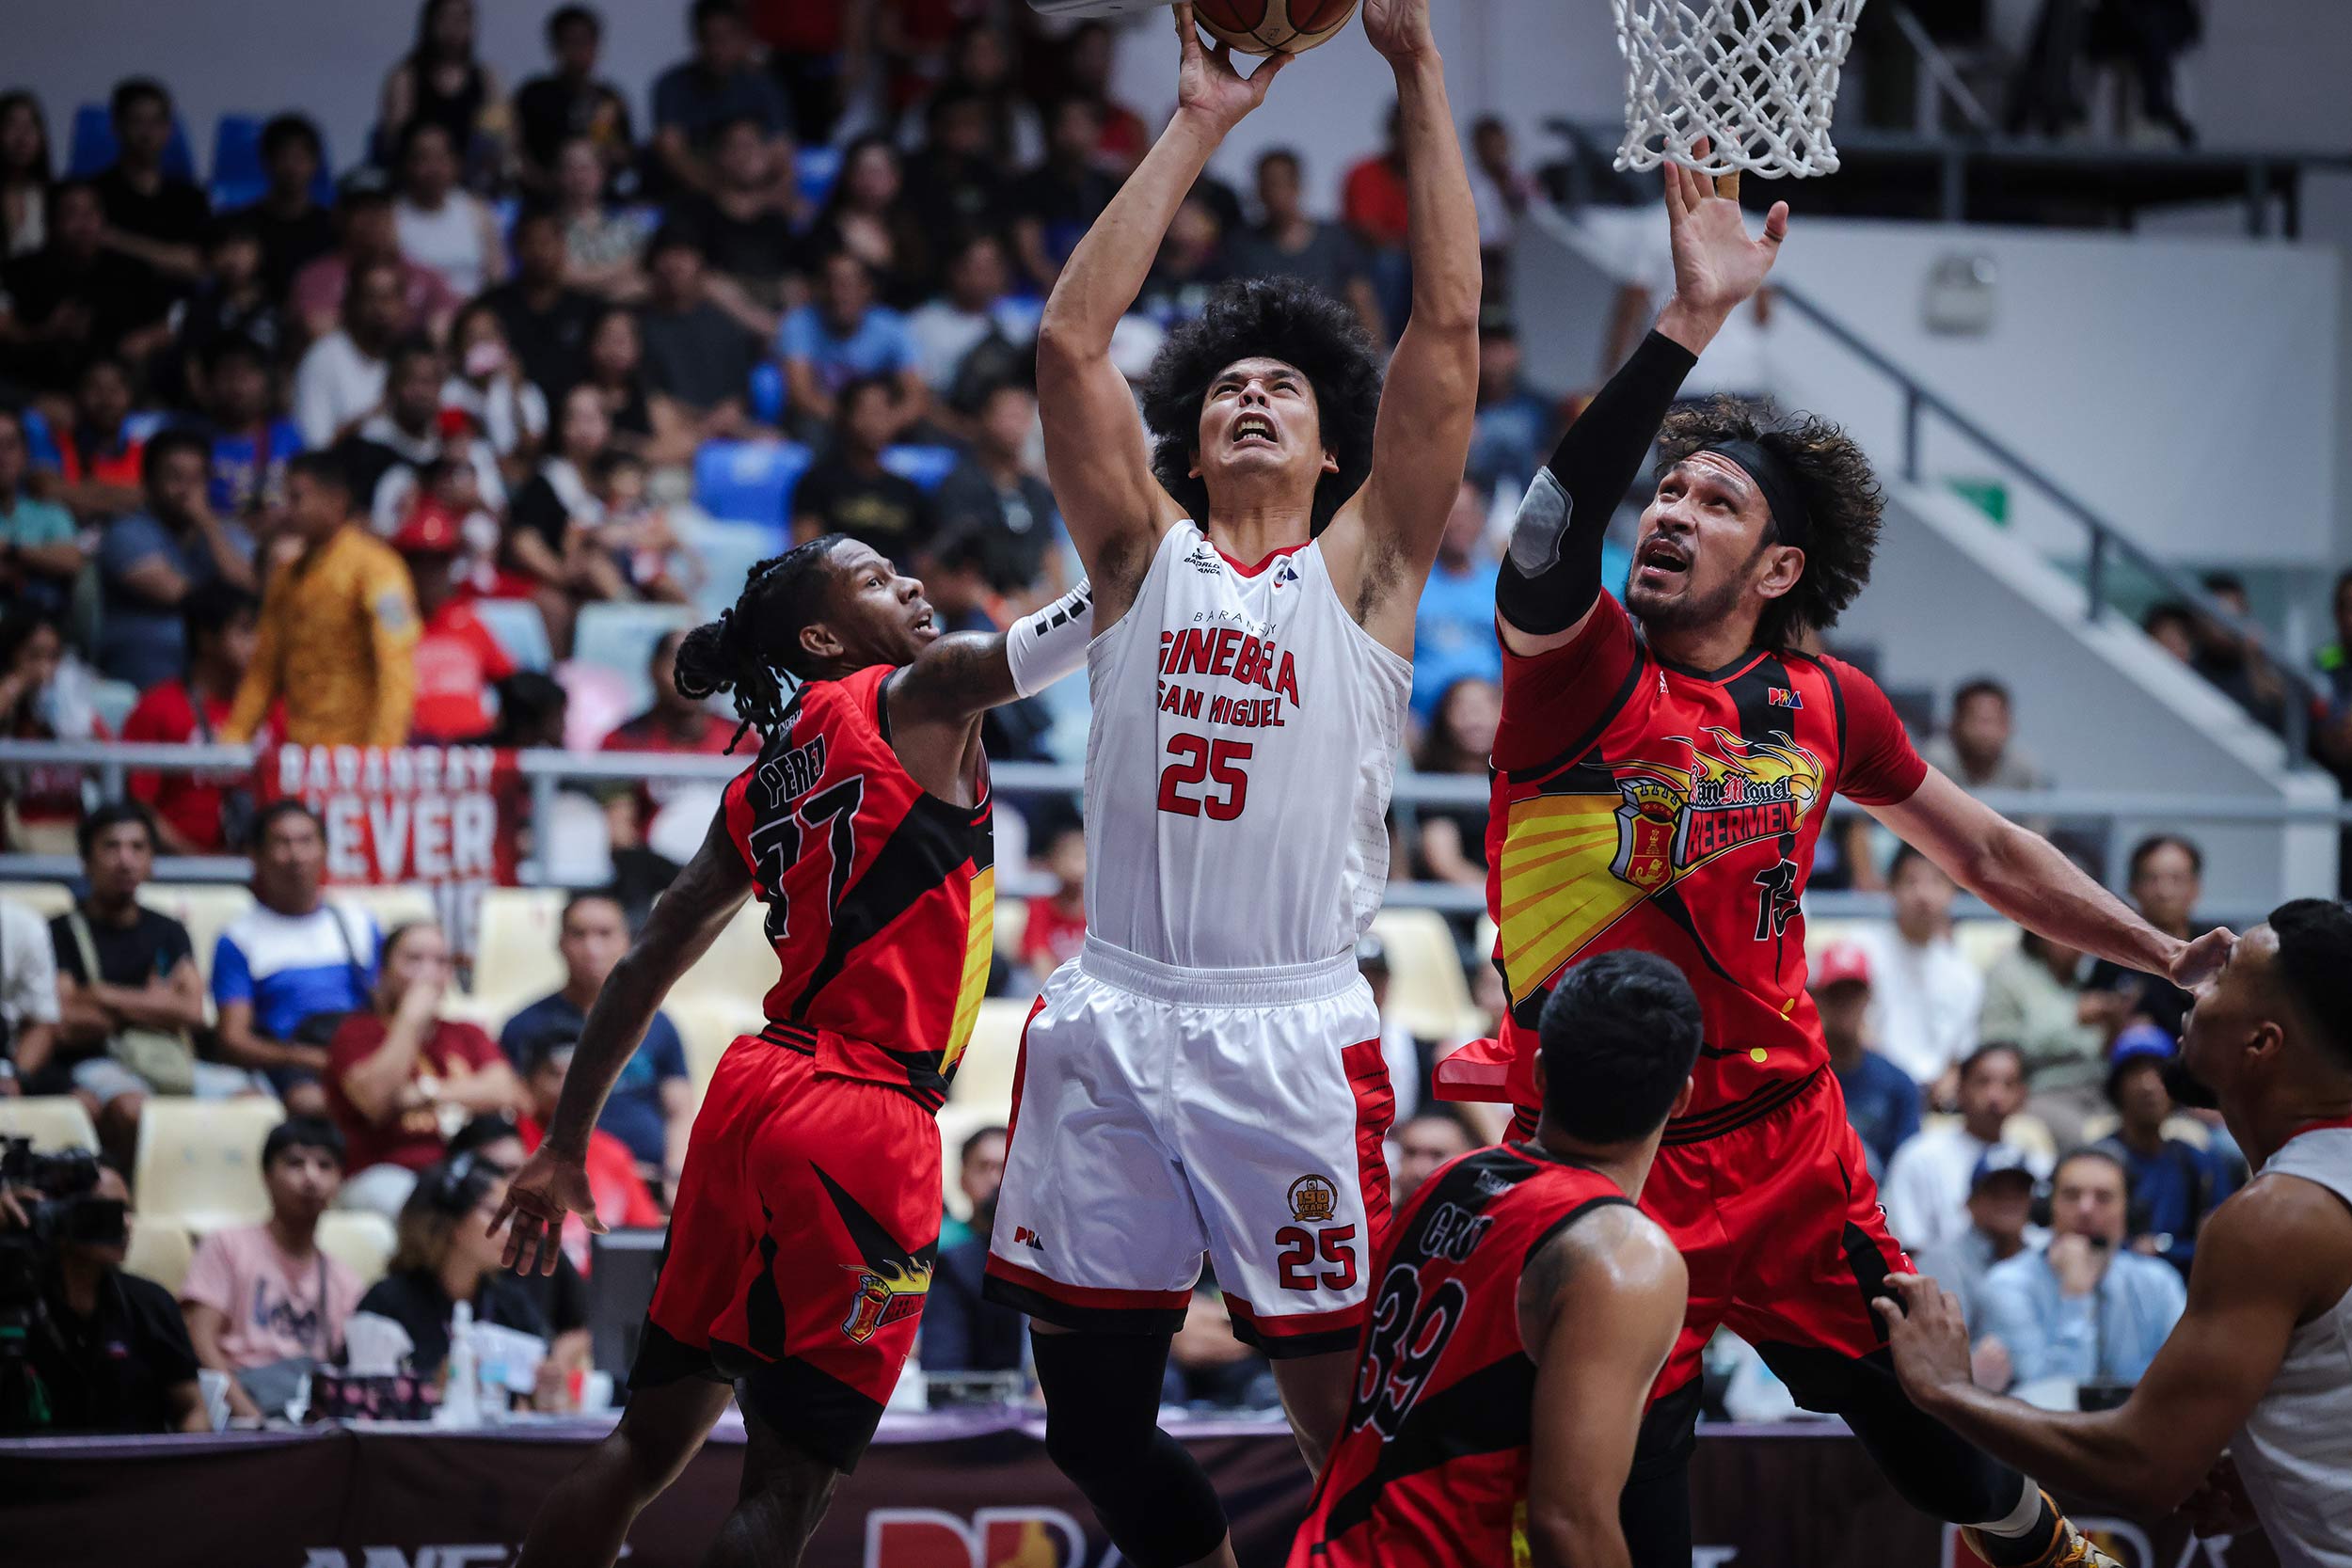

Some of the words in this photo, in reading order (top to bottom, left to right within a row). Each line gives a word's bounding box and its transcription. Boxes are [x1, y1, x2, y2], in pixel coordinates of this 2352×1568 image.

[1208, 694, 1285, 727] MIGUEL
[1768, 687, 1804, 710] PBA
[1158, 733, 1253, 821] 25
[1721, 773, 1792, 805] Miguel
[305, 793, 498, 878] EVER
[748, 774, 864, 939] 77
[1685, 800, 1798, 864] BEERMEN
[1753, 857, 1803, 942] 15
[1013, 1226, 1044, 1251] PBA
[1298, 1203, 1329, 1212] YEARS
[1275, 1224, 1357, 1291] 25
